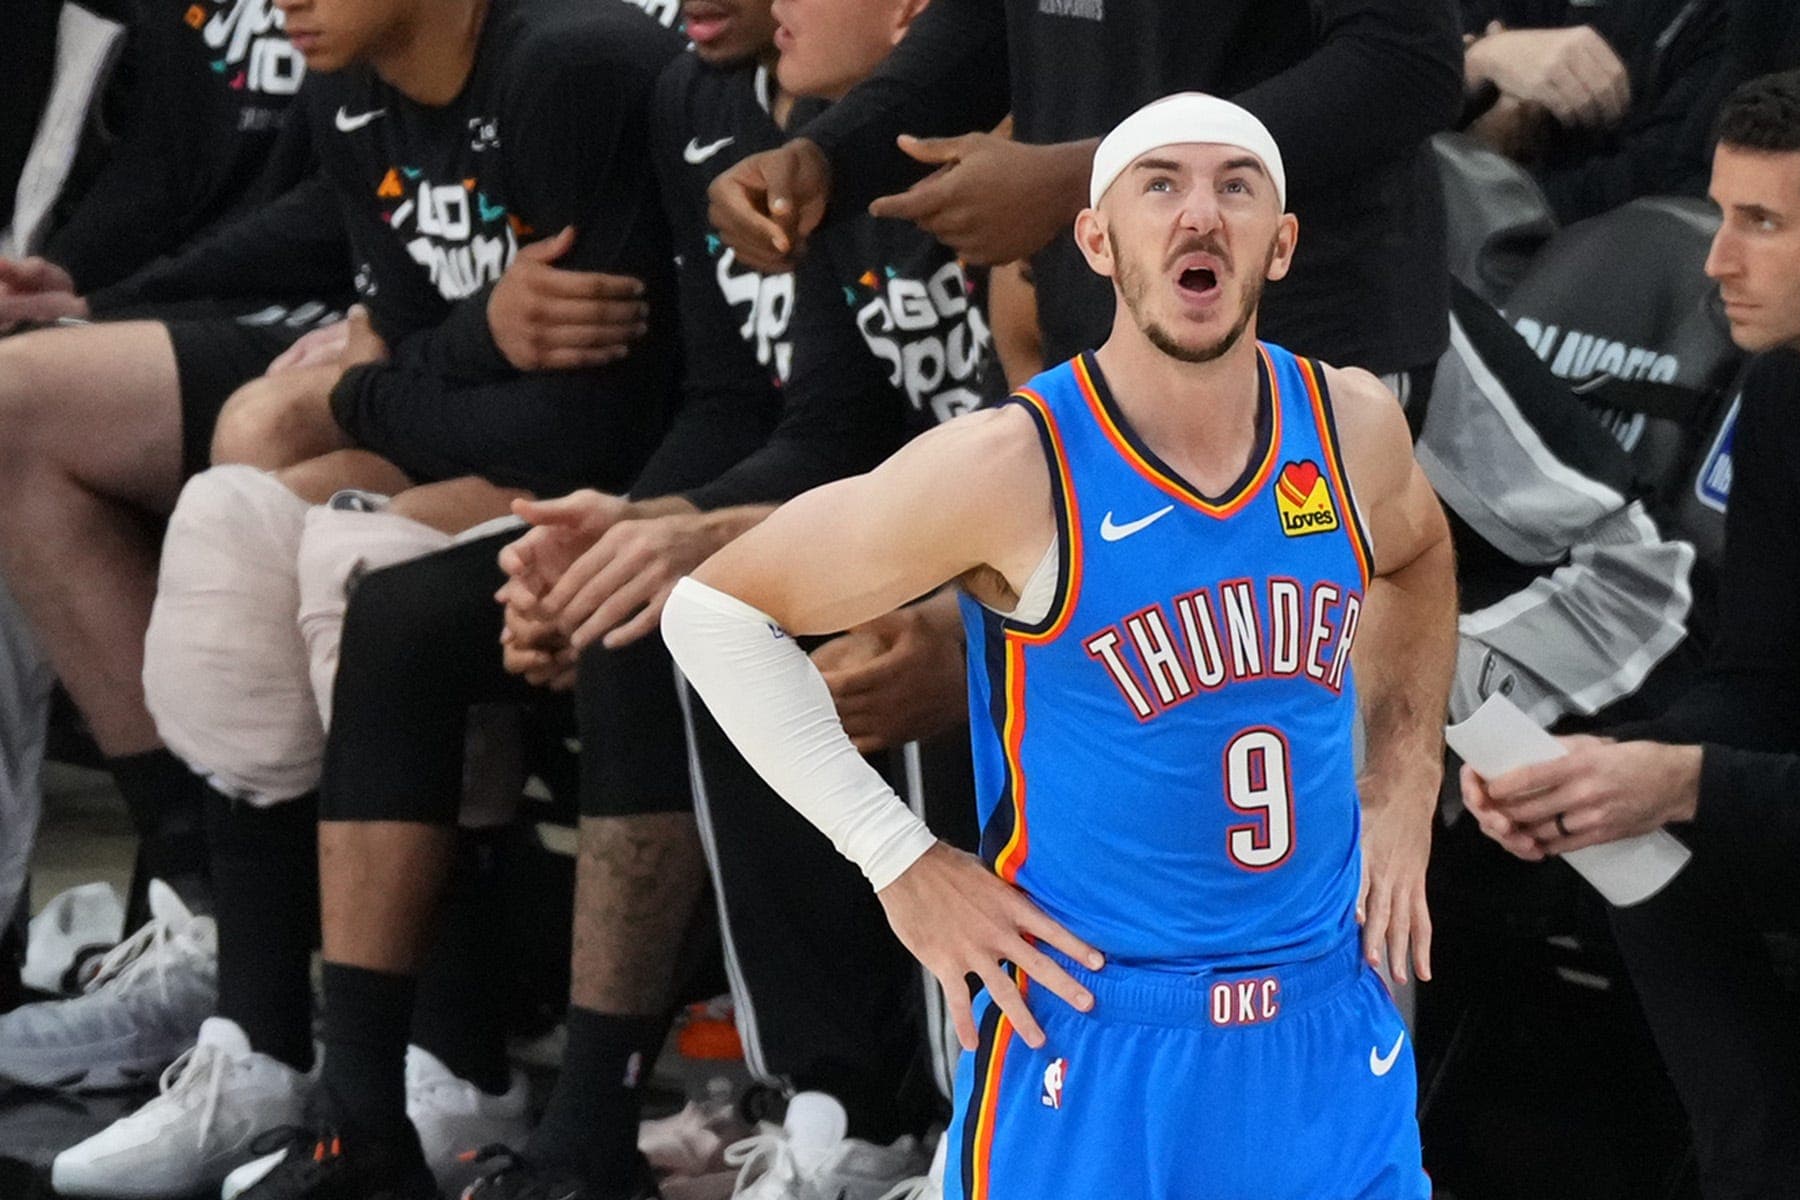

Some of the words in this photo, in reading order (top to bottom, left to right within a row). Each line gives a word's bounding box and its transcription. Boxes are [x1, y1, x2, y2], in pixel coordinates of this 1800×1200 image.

[1082, 576, 1363, 723] THUNDER
[1223, 725, 1296, 872] 9
[1211, 977, 1280, 1027] OKC
